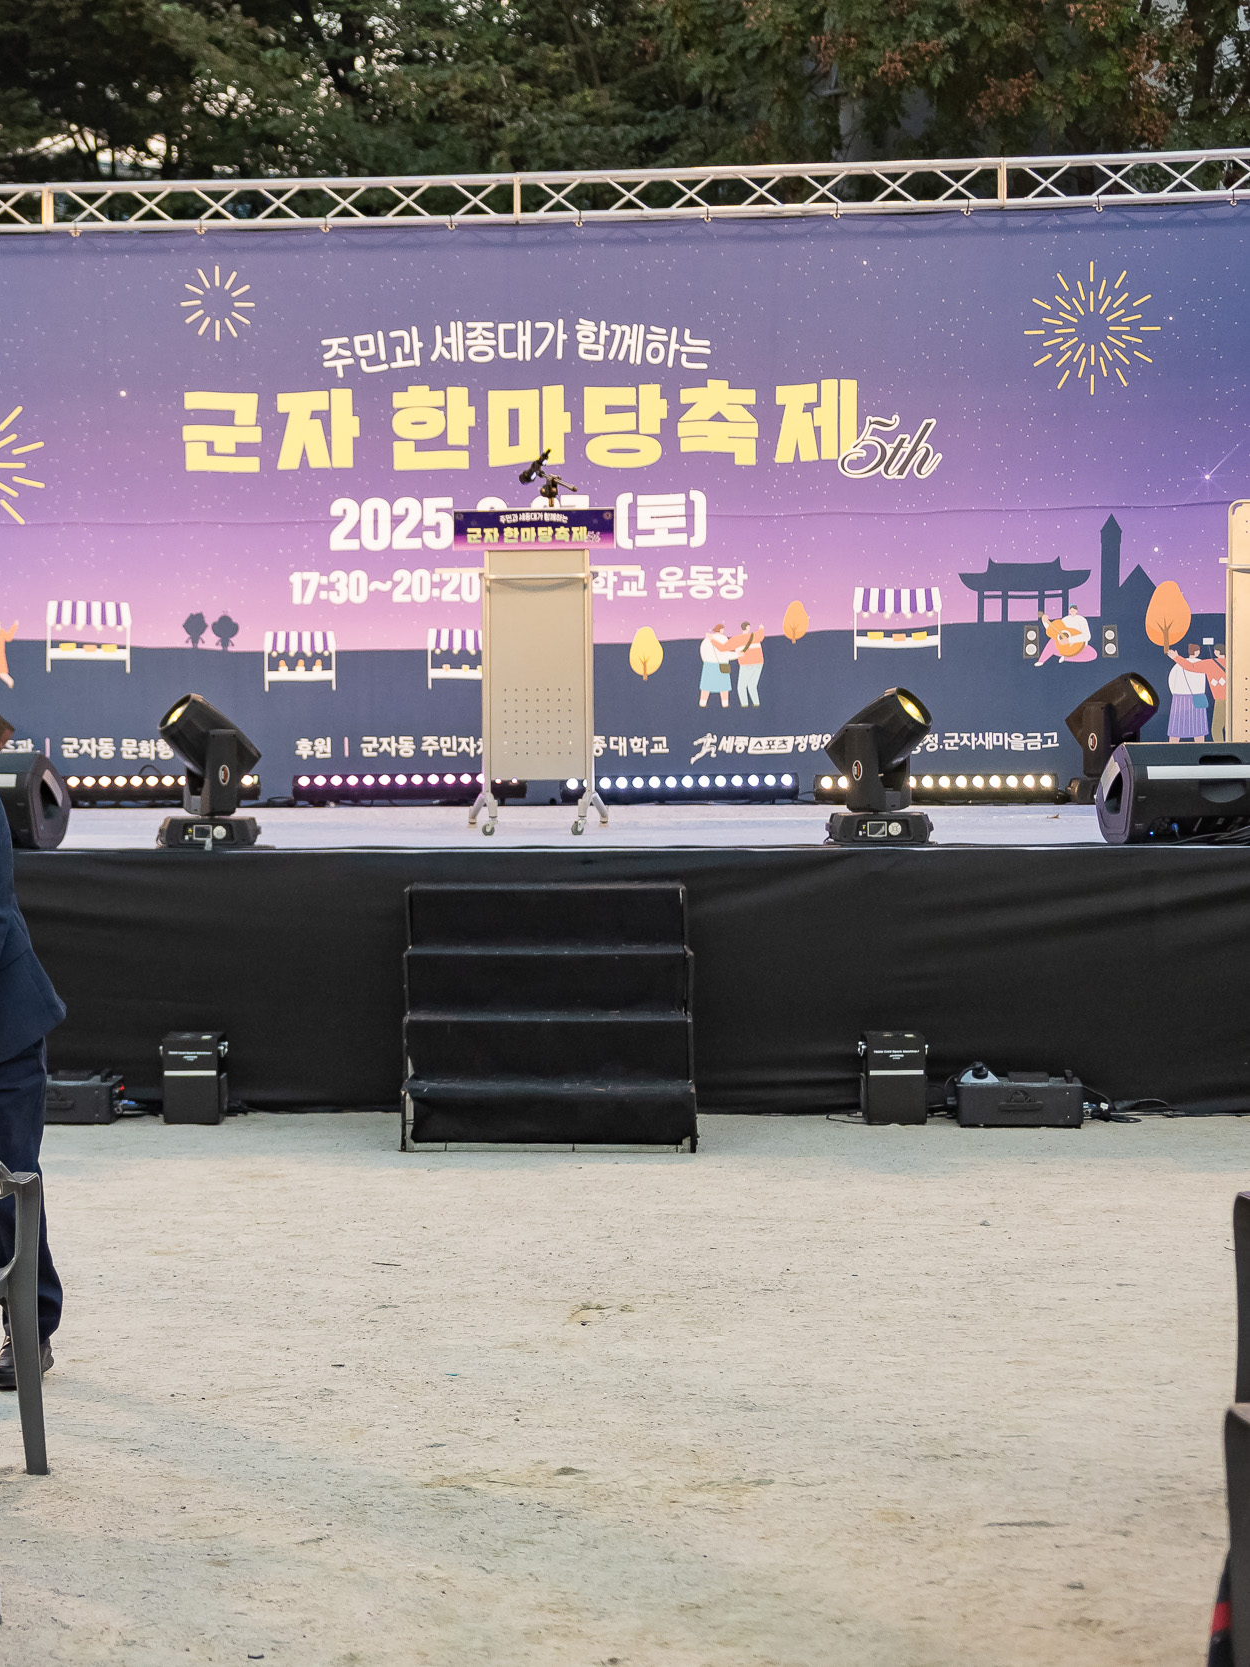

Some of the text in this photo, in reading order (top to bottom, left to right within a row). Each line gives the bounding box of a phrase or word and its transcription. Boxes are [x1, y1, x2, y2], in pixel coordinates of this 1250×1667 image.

[320, 318, 712, 378] 주민과 세종대가 함께하는
[181, 378, 943, 481] 군자 한마당축제 5th
[329, 489, 708, 551] 2025 (토)
[466, 527, 500, 544] 군자
[503, 526, 588, 544] 한마당축제
[289, 566, 748, 605] 17:30~20:20 학교 운동장
[61, 737, 117, 760] 군자동
[295, 736, 332, 760] 후원
[360, 735, 416, 758] 군자동
[593, 735, 670, 757] 종대학교
